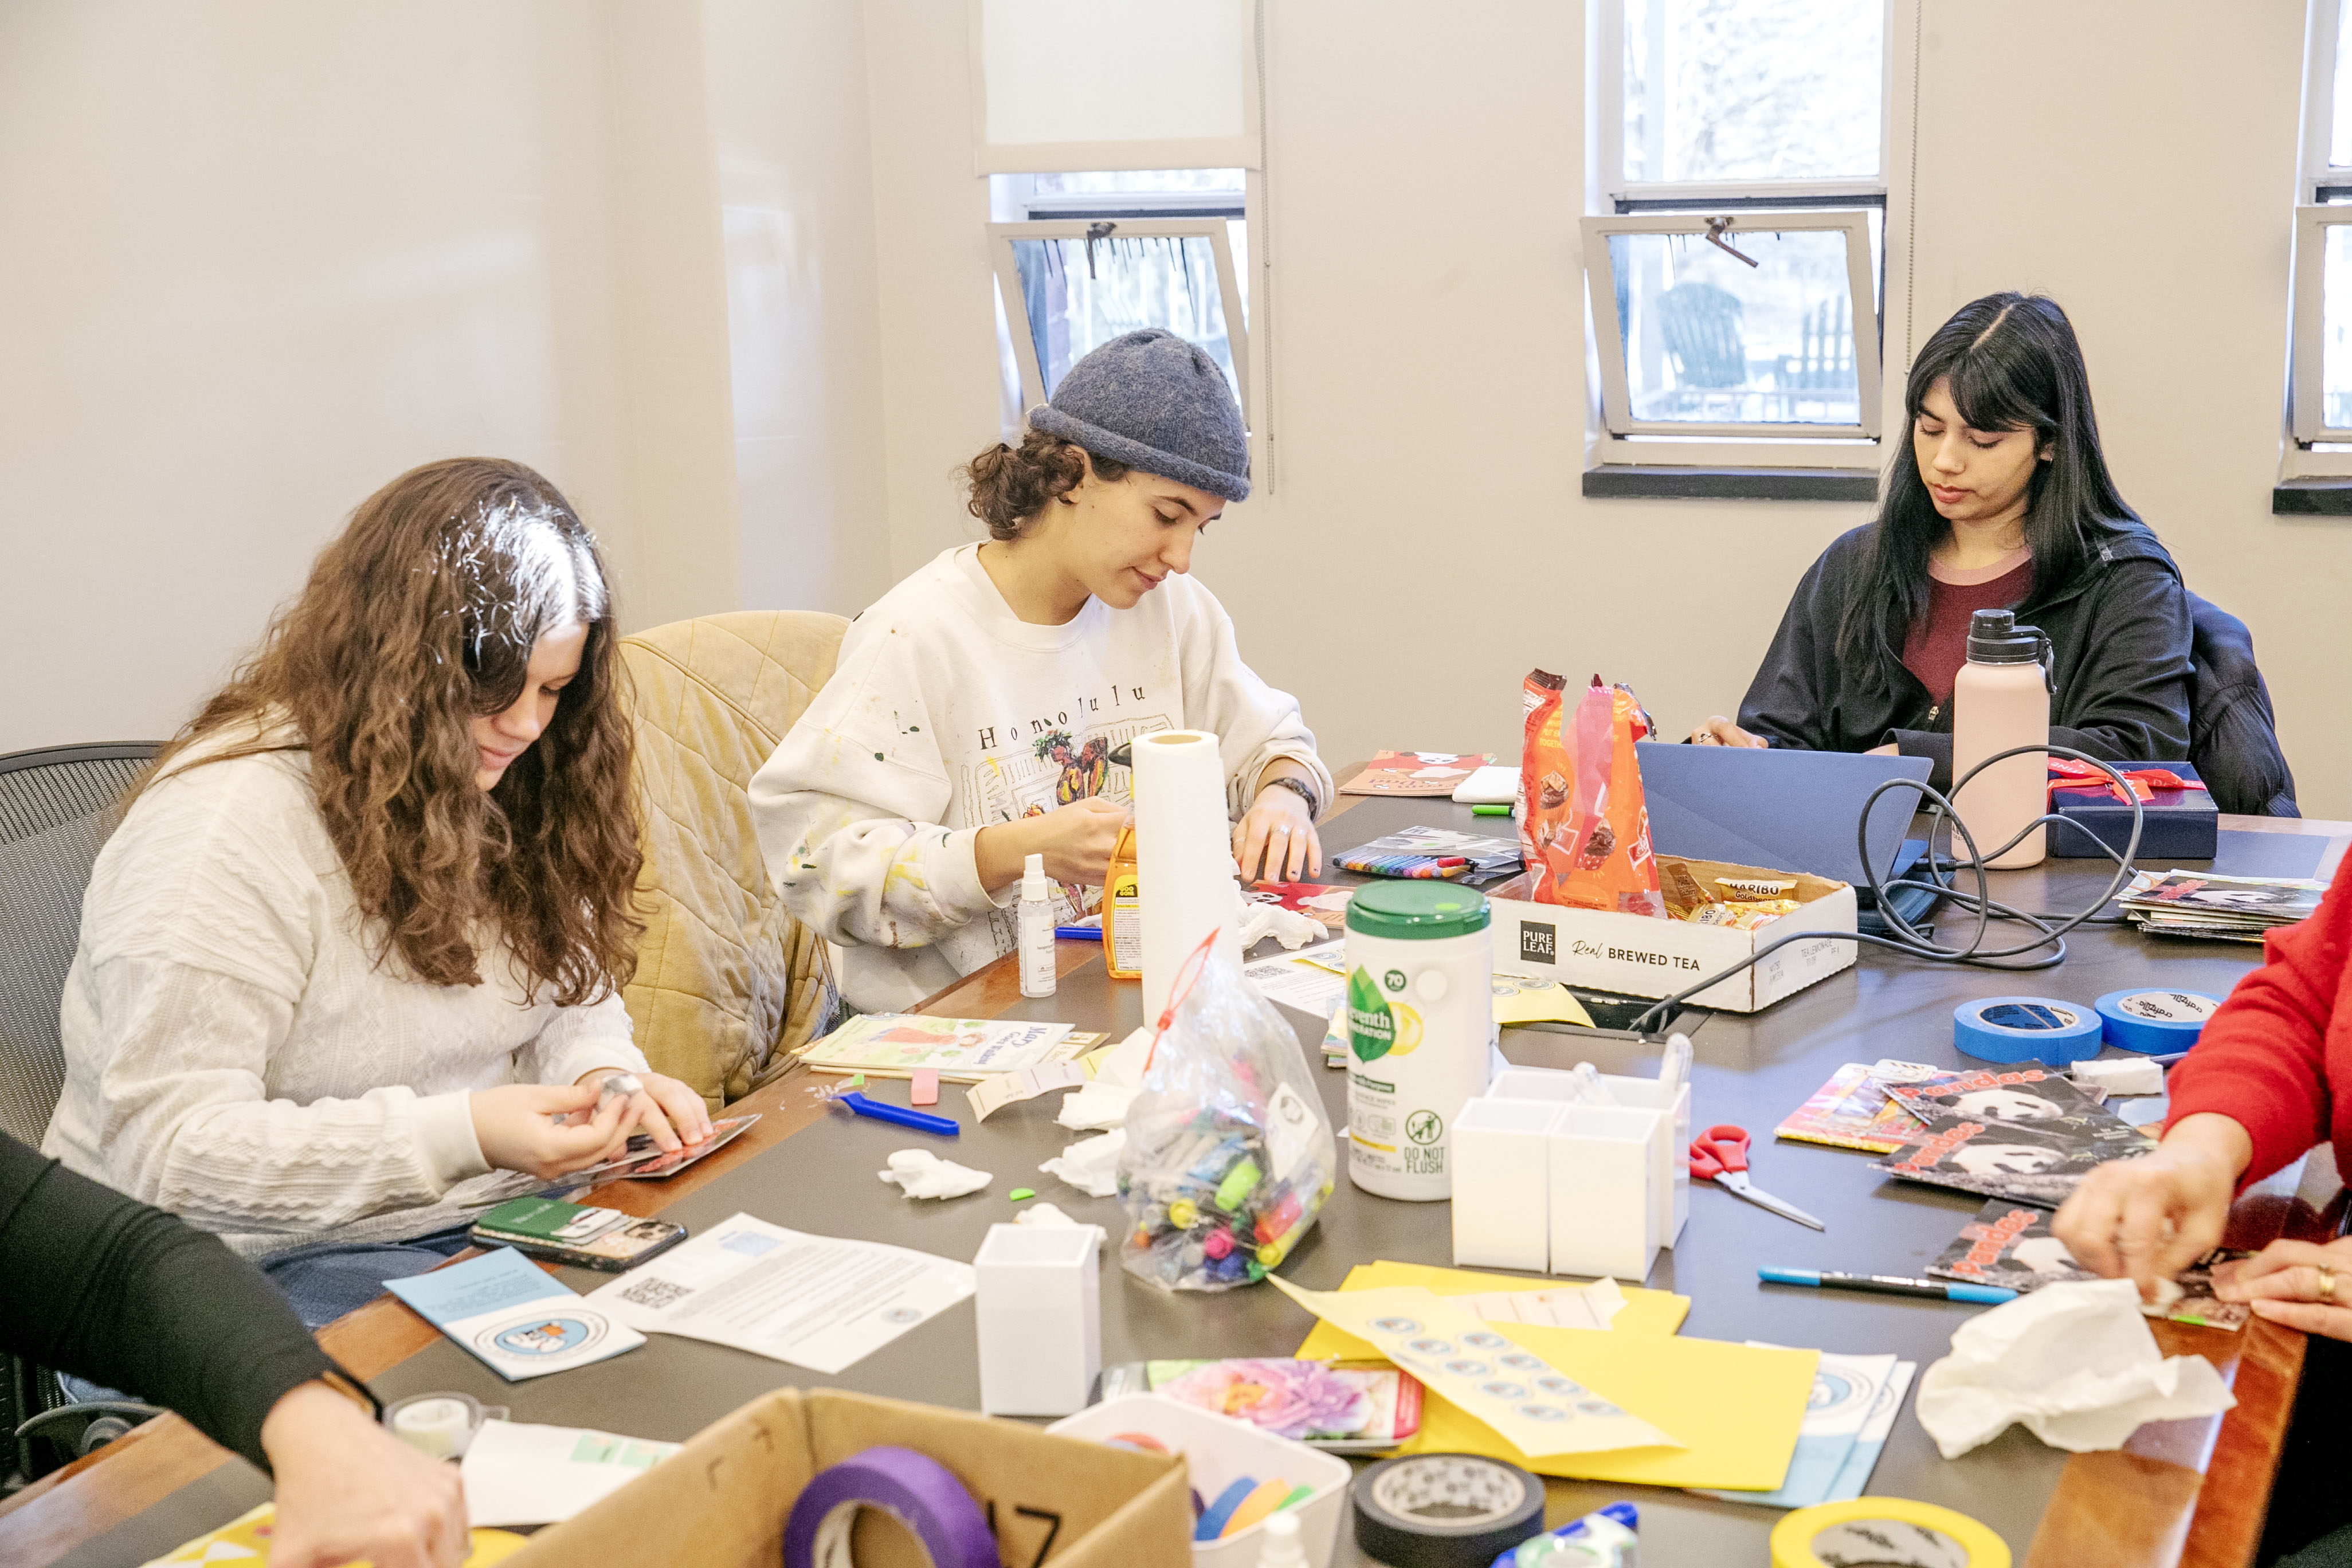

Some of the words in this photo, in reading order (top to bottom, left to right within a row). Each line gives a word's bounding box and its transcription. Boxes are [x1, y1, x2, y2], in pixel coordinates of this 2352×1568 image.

[978, 685, 1146, 750] Honolulu
[1539, 738, 1564, 748] TOGETH
[1523, 930, 1554, 944] PURE
[1572, 940, 1604, 959] Real
[1609, 948, 1668, 966] BREWED
[1673, 957, 1700, 971] TEA
[1387, 973, 1404, 987] 70
[2139, 1000, 2173, 1018] craftzilla
[1894, 1069, 2048, 1100] Pandas
[1404, 1147, 1419, 1161] DO
[1424, 1147, 1445, 1161] NOT
[1893, 1122, 1985, 1174] Pandas
[1406, 1160, 1444, 1174] FLUSH
